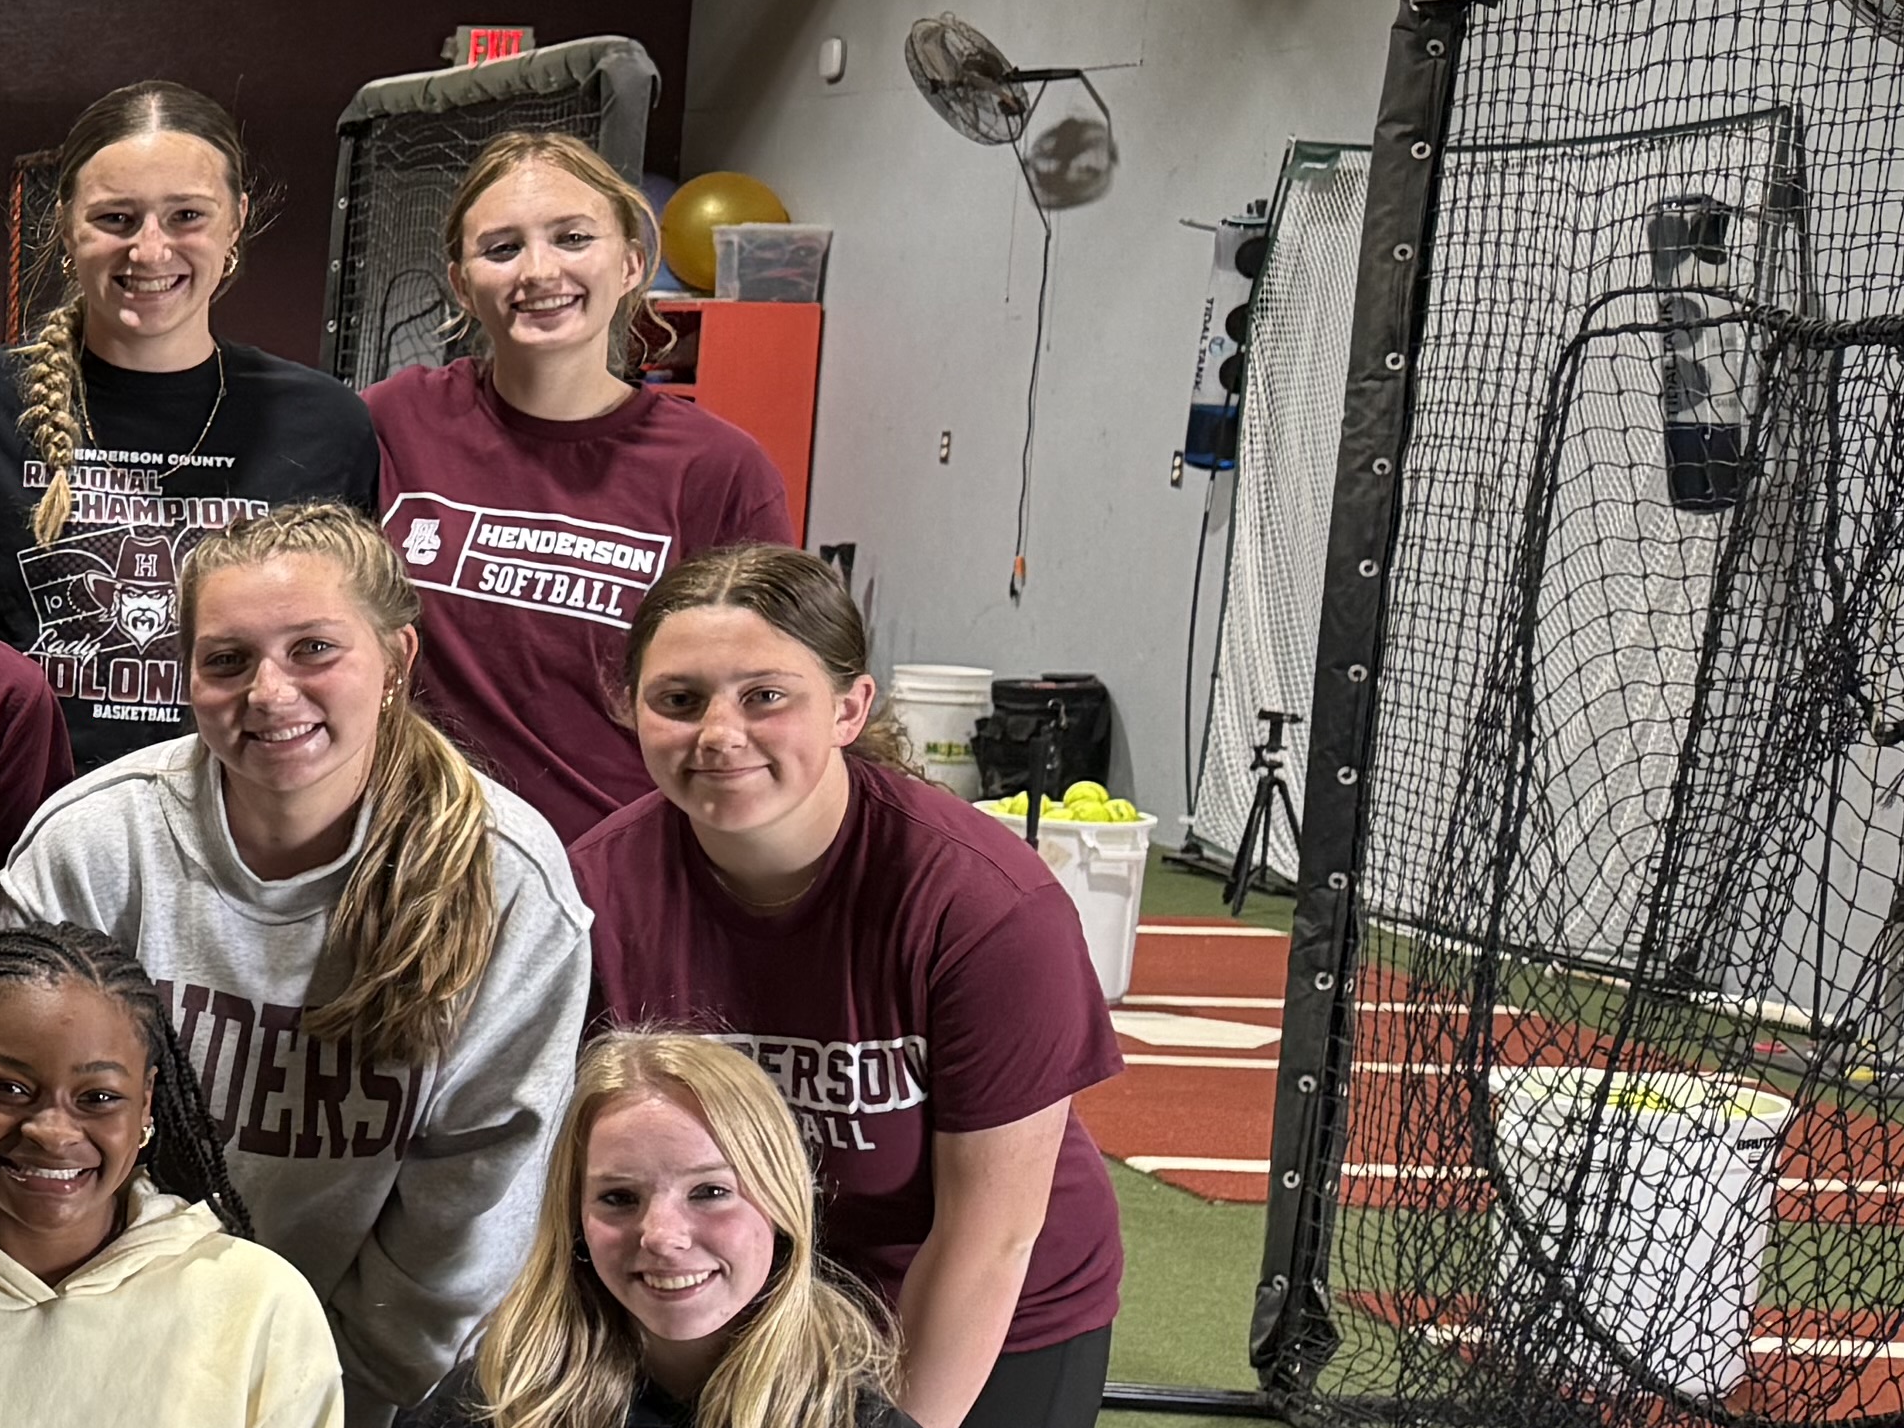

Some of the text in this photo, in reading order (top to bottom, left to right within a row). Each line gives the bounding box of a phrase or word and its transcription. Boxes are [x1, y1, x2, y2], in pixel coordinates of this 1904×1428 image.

[23, 460, 164, 496] RIONAL
[73, 449, 236, 469] ENDERSON COUNTY
[134, 554, 158, 578] H
[476, 523, 657, 574] HENDERSON
[478, 564, 624, 617] SOFTBALL
[24, 628, 102, 672] Lady
[42, 653, 191, 706] OLON
[92, 704, 181, 723] BASKETBALL
